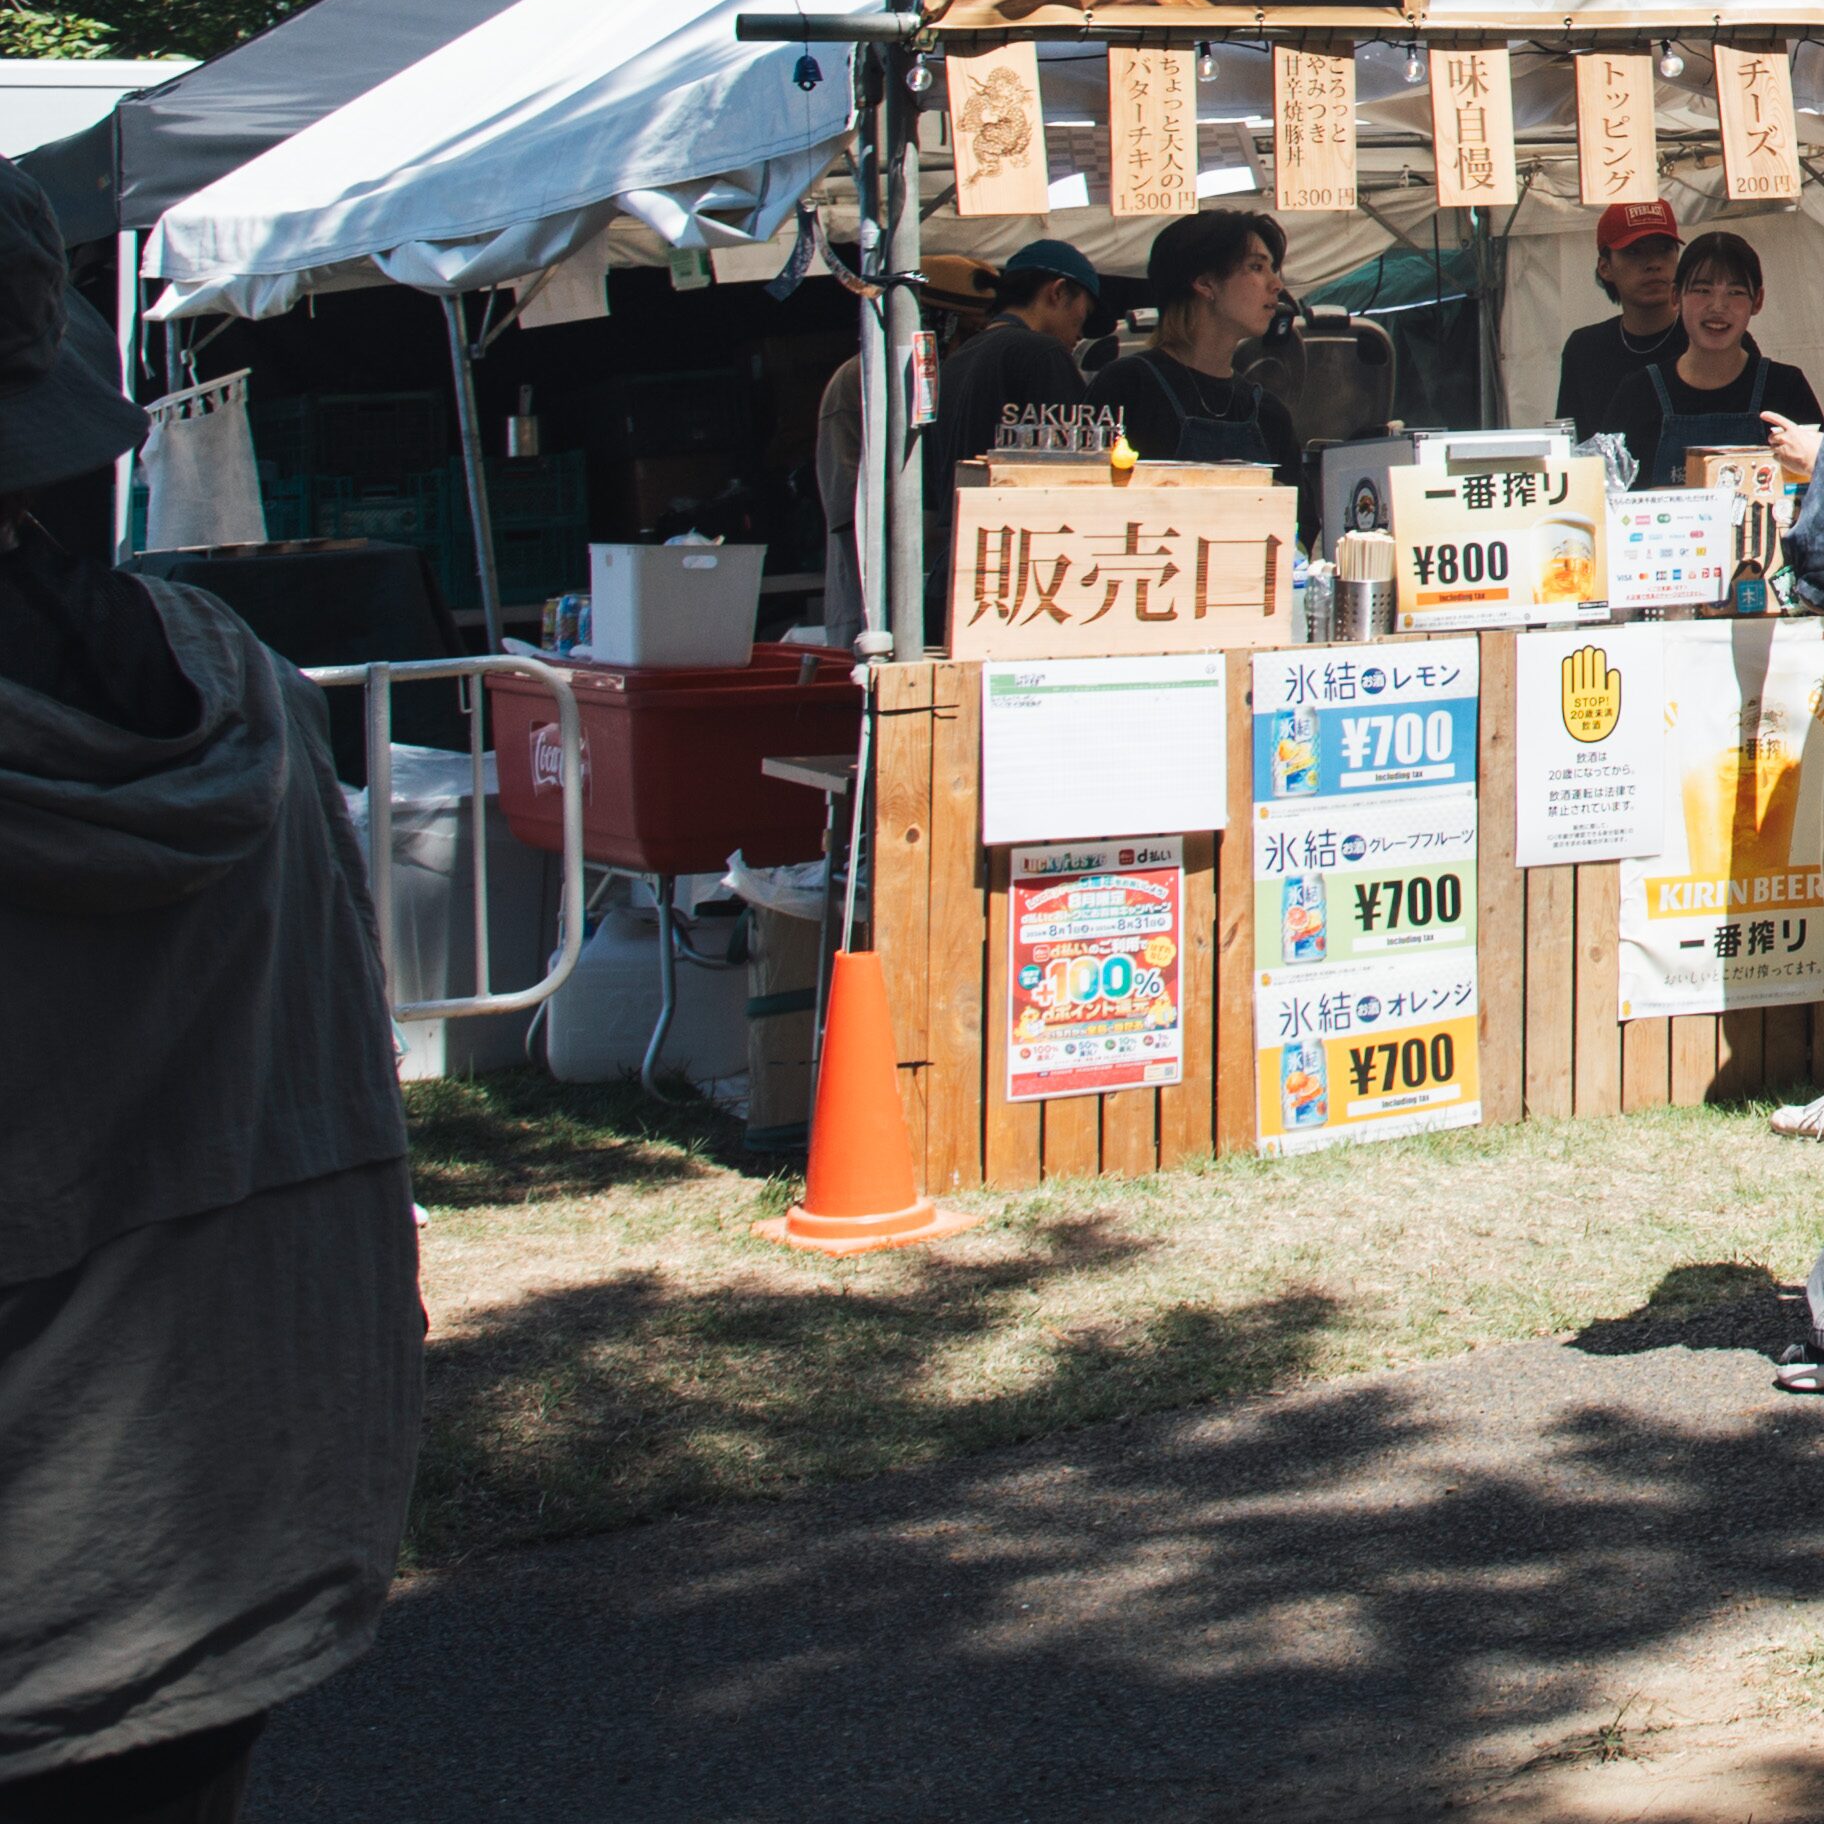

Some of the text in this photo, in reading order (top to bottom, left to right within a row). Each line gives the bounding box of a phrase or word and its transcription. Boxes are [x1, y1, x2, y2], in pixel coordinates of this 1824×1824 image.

[1283, 55, 1306, 170] 甘辛焼豚丼
[1306, 56, 1329, 145] やみつき
[1736, 58, 1779, 161] チーズ
[1124, 57, 1154, 192] バターチキン
[1158, 56, 1185, 190] ちょっと大人の
[1447, 54, 1496, 193] 味自慢
[1601, 60, 1637, 198] トッピング
[1735, 173, 1792, 194] 200円
[1001, 402, 1125, 427] SAKURAI
[1424, 471, 1569, 511] 一番搾り
[967, 520, 1283, 628] 販売口
[1412, 541, 1509, 586] ¥800
[1285, 662, 1357, 705] 氷結
[1393, 664, 1461, 690] レモン
[1574, 696, 1610, 708] STOP!
[1570, 708, 1613, 720] 20歳未満
[1581, 721, 1602, 731] 飲酒
[1341, 709, 1453, 770] ¥700
[1576, 751, 1608, 764] 飲酒は
[1549, 764, 1636, 781] 20歳になってから。
[1549, 784, 1637, 802] 飲酒運転は法律で
[1547, 801, 1635, 818] 禁止されています。
[1264, 830, 1337, 873] 氷結
[1368, 829, 1476, 855] グレープフルーツ
[1354, 873, 1462, 932] ¥700
[1658, 877, 1748, 913] KIRIN
[1679, 918, 1807, 959] 一番搾り
[1279, 992, 1352, 1039] 氷結
[1386, 982, 1472, 1017] オレンジ
[1349, 1032, 1454, 1096] ¥700
